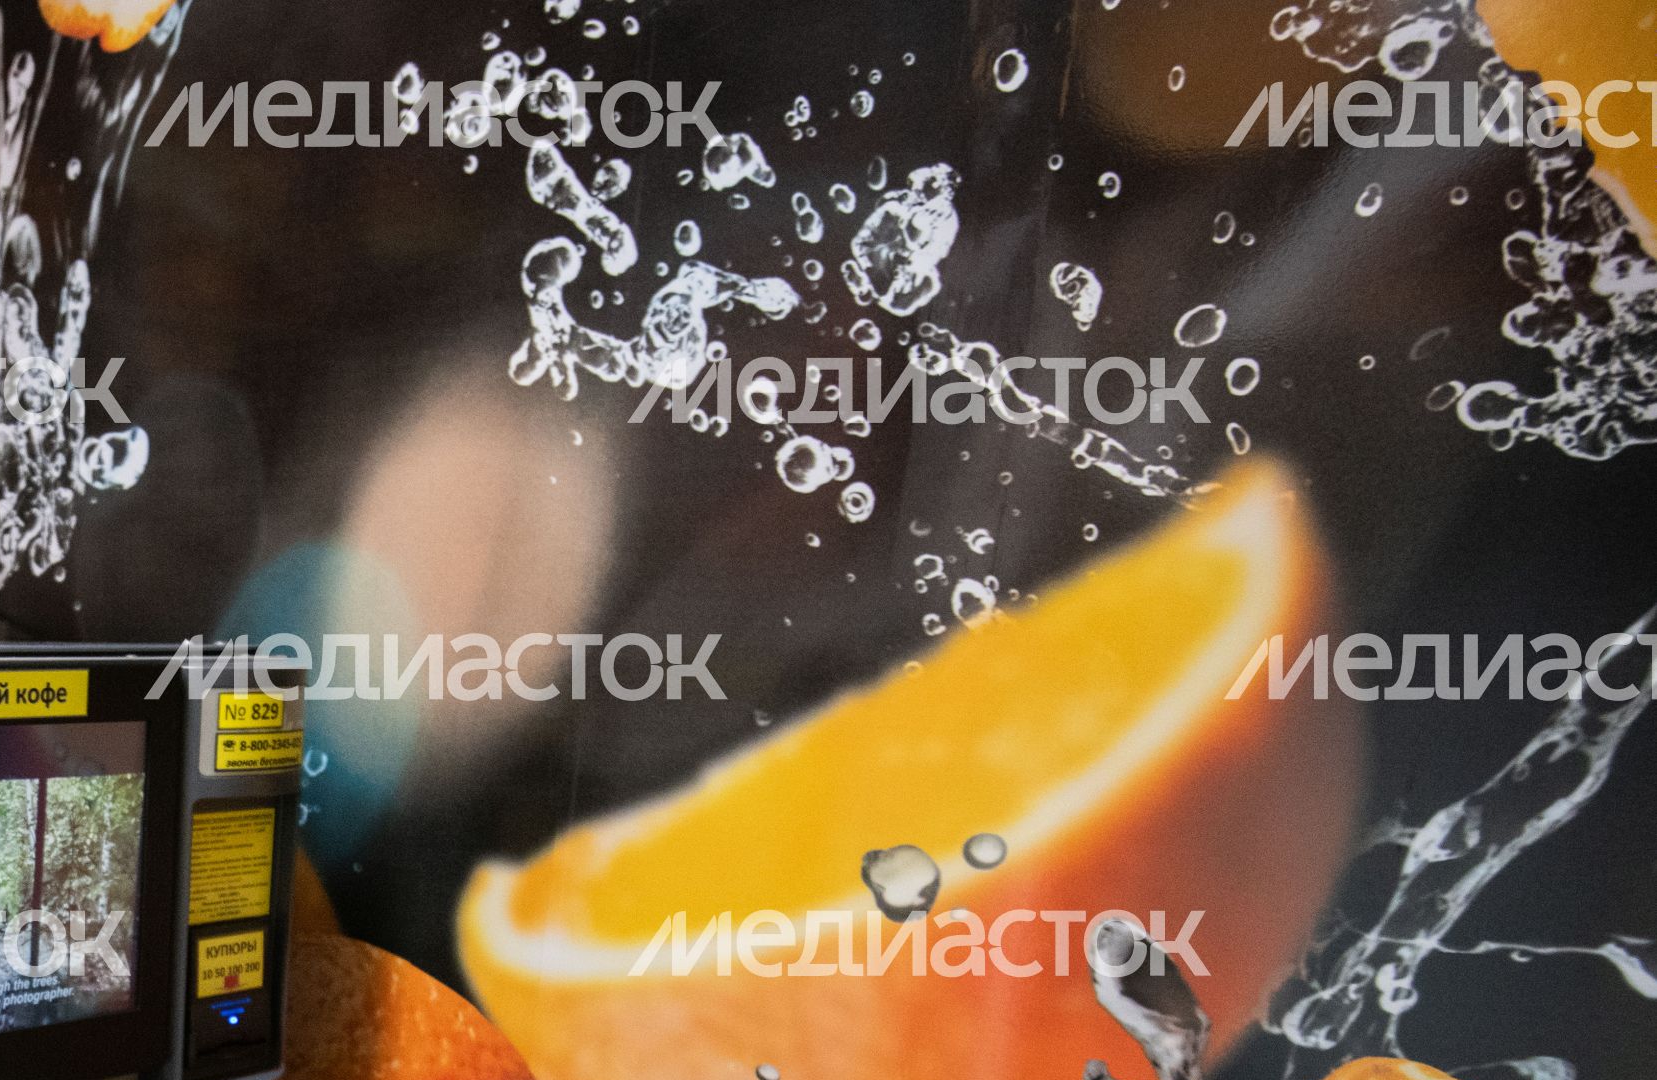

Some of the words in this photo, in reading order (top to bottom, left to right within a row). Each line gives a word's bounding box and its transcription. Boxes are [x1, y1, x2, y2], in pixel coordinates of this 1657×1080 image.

[16, 685, 68, 711] кофе
[225, 703, 246, 720] №
[251, 702, 280, 720] 829
[206, 940, 257, 960] КУПЮРЫ
[228, 963, 243, 976] 100
[245, 961, 260, 973] 200
[14, 978, 30, 992] the
[33, 976, 59, 988] trees.
[3, 985, 75, 1008] photographer.
